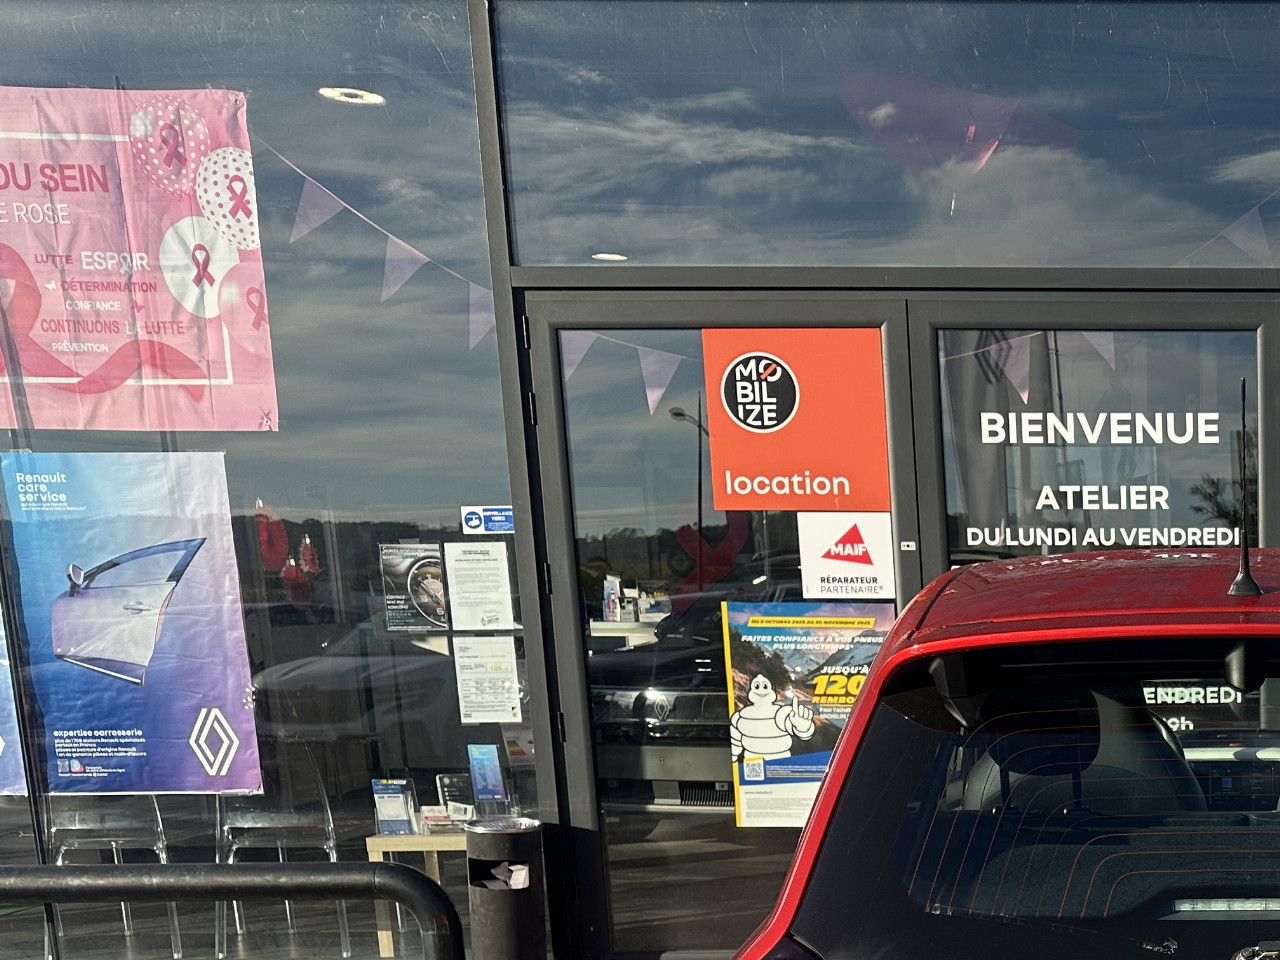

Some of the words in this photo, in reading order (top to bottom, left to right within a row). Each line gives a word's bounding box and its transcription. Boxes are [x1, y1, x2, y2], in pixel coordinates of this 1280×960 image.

[39, 162, 110, 193] SEIN
[13, 202, 71, 225] ROSE
[34, 253, 74, 265] LUTTE
[80, 251, 150, 274] ESPOIR
[62, 276, 158, 293] DÉTERMINATION
[65, 300, 122, 311] CONFIANCE
[40, 318, 120, 334] CONTINUONS
[125, 321, 142, 335] LA
[144, 320, 185, 335] LUTTE
[51, 339, 109, 353] PRÉVENTION
[736, 381, 777, 403] BIL
[737, 404, 778, 426] IZE
[980, 412, 1220, 444] BIENVENUE
[16, 472, 67, 483] Renault
[725, 470, 850, 495] location
[17, 483, 48, 492] care
[18, 491, 67, 502] service
[1035, 485, 1170, 511] ATELIER
[966, 527, 1000, 546] DU
[1005, 527, 1077, 546] LUNDI
[1082, 527, 1116, 546] AU
[1119, 527, 1240, 546] VENDREDI
[830, 543, 867, 556] MAIF
[820, 574, 878, 584] RÉPARATEUR
[812, 696, 857, 704] REMBO
[1143, 686, 1242, 704] ENDREDI
[53, 729, 93, 738] expertise
[93, 728, 143, 737] carrosserie
